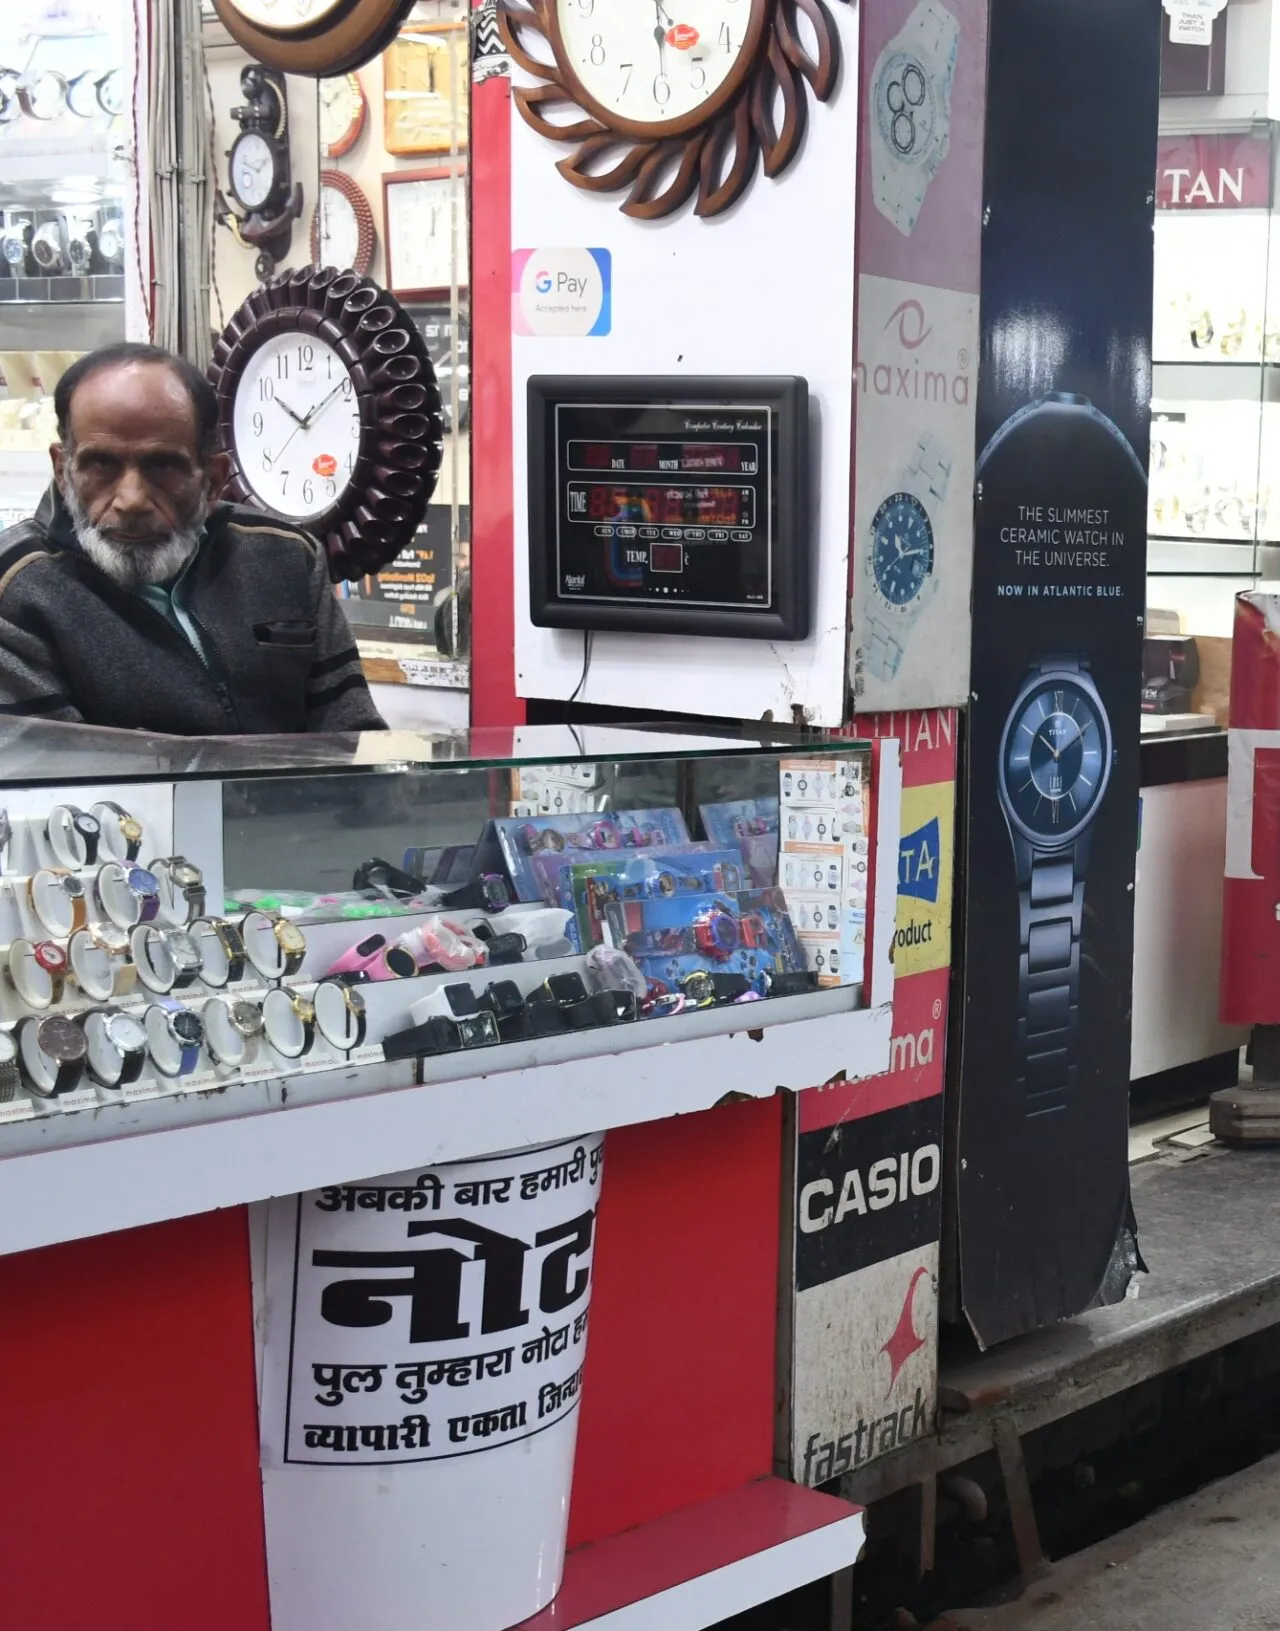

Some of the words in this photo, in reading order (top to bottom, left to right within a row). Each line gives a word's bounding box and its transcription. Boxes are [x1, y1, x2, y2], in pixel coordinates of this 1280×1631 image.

[591, 33, 606, 66] 8
[717, 21, 730, 54] 4
[619, 63, 634, 96] 7
[690, 57, 706, 90] 5
[652, 72, 671, 105] 6
[1157, 167, 1244, 204] TAN
[536, 271, 551, 293] G
[557, 272, 587, 298] Pay
[277, 354, 289, 379] 11
[297, 345, 314, 371] 12
[258, 376, 274, 402] 10
[341, 377, 352, 403] 2
[253, 412, 264, 438] 9
[262, 448, 273, 473] 8
[659, 460, 678, 470] MONTH
[741, 461, 756, 471] YEAR
[280, 470, 289, 496] 7
[302, 479, 314, 505] 6
[570, 491, 586, 512] TIME
[1019, 506, 1043, 521] THE
[1048, 507, 1109, 524] SLIMMEST
[1000, 528, 1060, 544] CERAMIC
[1064, 530, 1107, 545] WATCH
[1112, 532, 1124, 545] IN
[626, 551, 648, 563] TEMP.
[1015, 550, 1040, 565] THE
[1044, 551, 1110, 567] UNIVERSE.
[998, 585, 1023, 596] NOW
[1028, 586, 1038, 596] IN
[1044, 586, 1092, 596] ATLANTIC
[1097, 586, 1124, 596] BLUE.
[894, 919, 932, 947] roduct
[315, 1173, 444, 1213] अबकी
[455, 1176, 514, 1207] बार
[520, 1146, 586, 1200] हमारी
[800, 1143, 939, 1234] CASIO
[312, 1209, 597, 1344] नोट
[312, 1362, 387, 1406] पुल
[395, 1346, 514, 1405] तुम्हारा
[521, 1325, 570, 1364] नोटा
[303, 1414, 431, 1453] व्यापारी
[448, 1399, 527, 1444] एकता
[804, 1388, 927, 1486] fastrack
